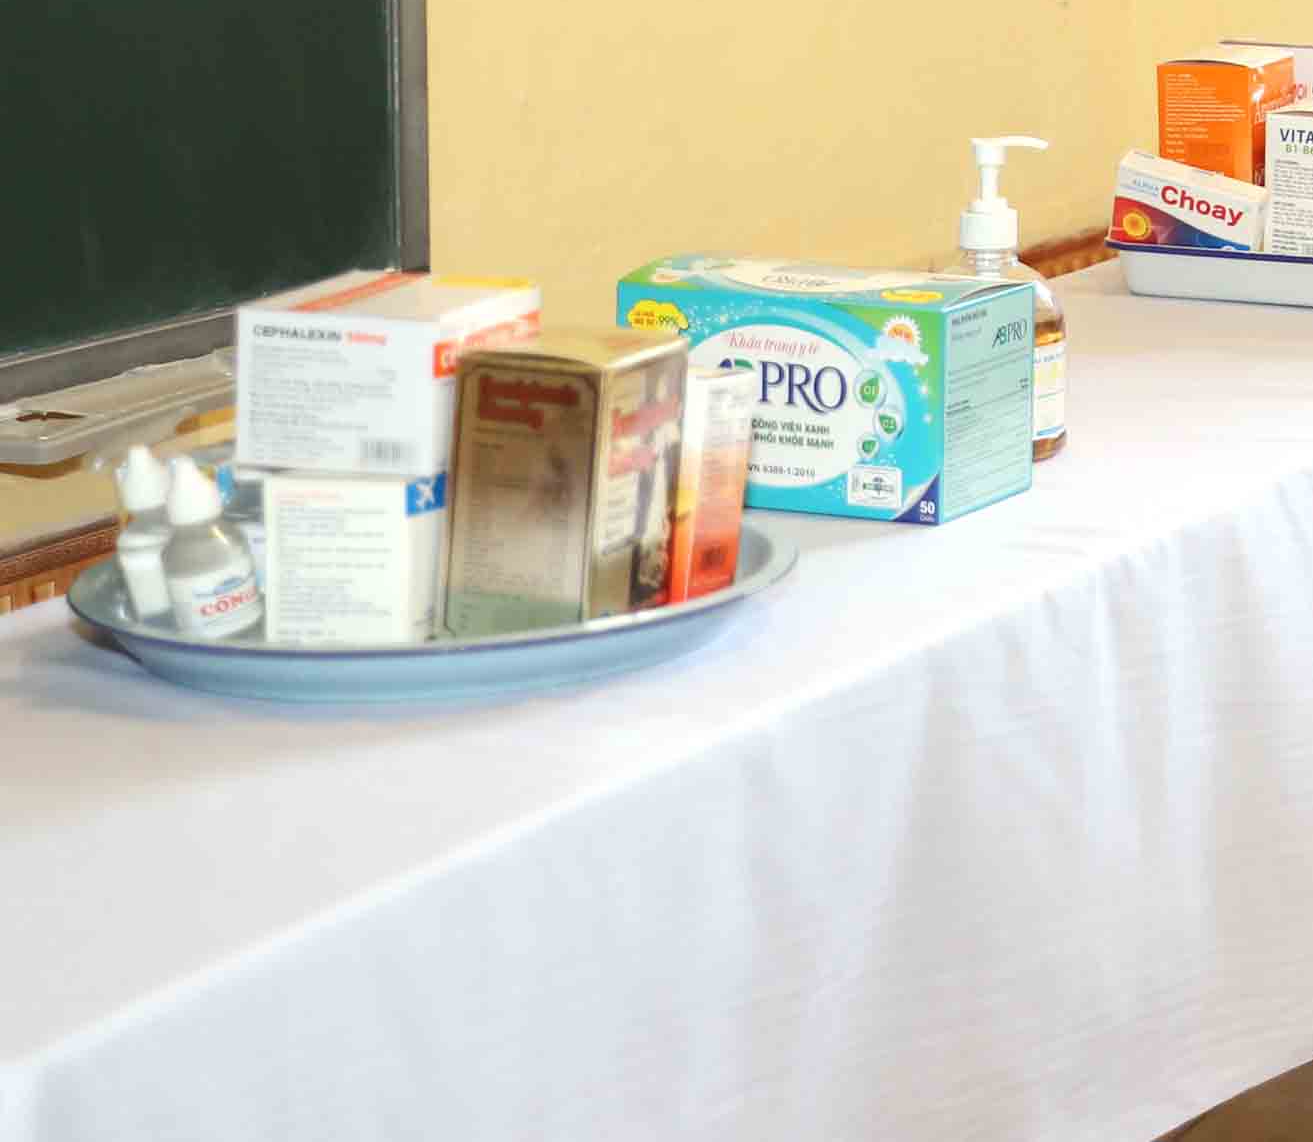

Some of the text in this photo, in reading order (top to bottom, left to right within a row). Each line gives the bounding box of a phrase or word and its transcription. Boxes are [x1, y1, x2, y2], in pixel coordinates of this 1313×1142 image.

[1160, 184, 1243, 227] Choay
[720, 357, 848, 414] PRO
[919, 500, 936, 515] 50
